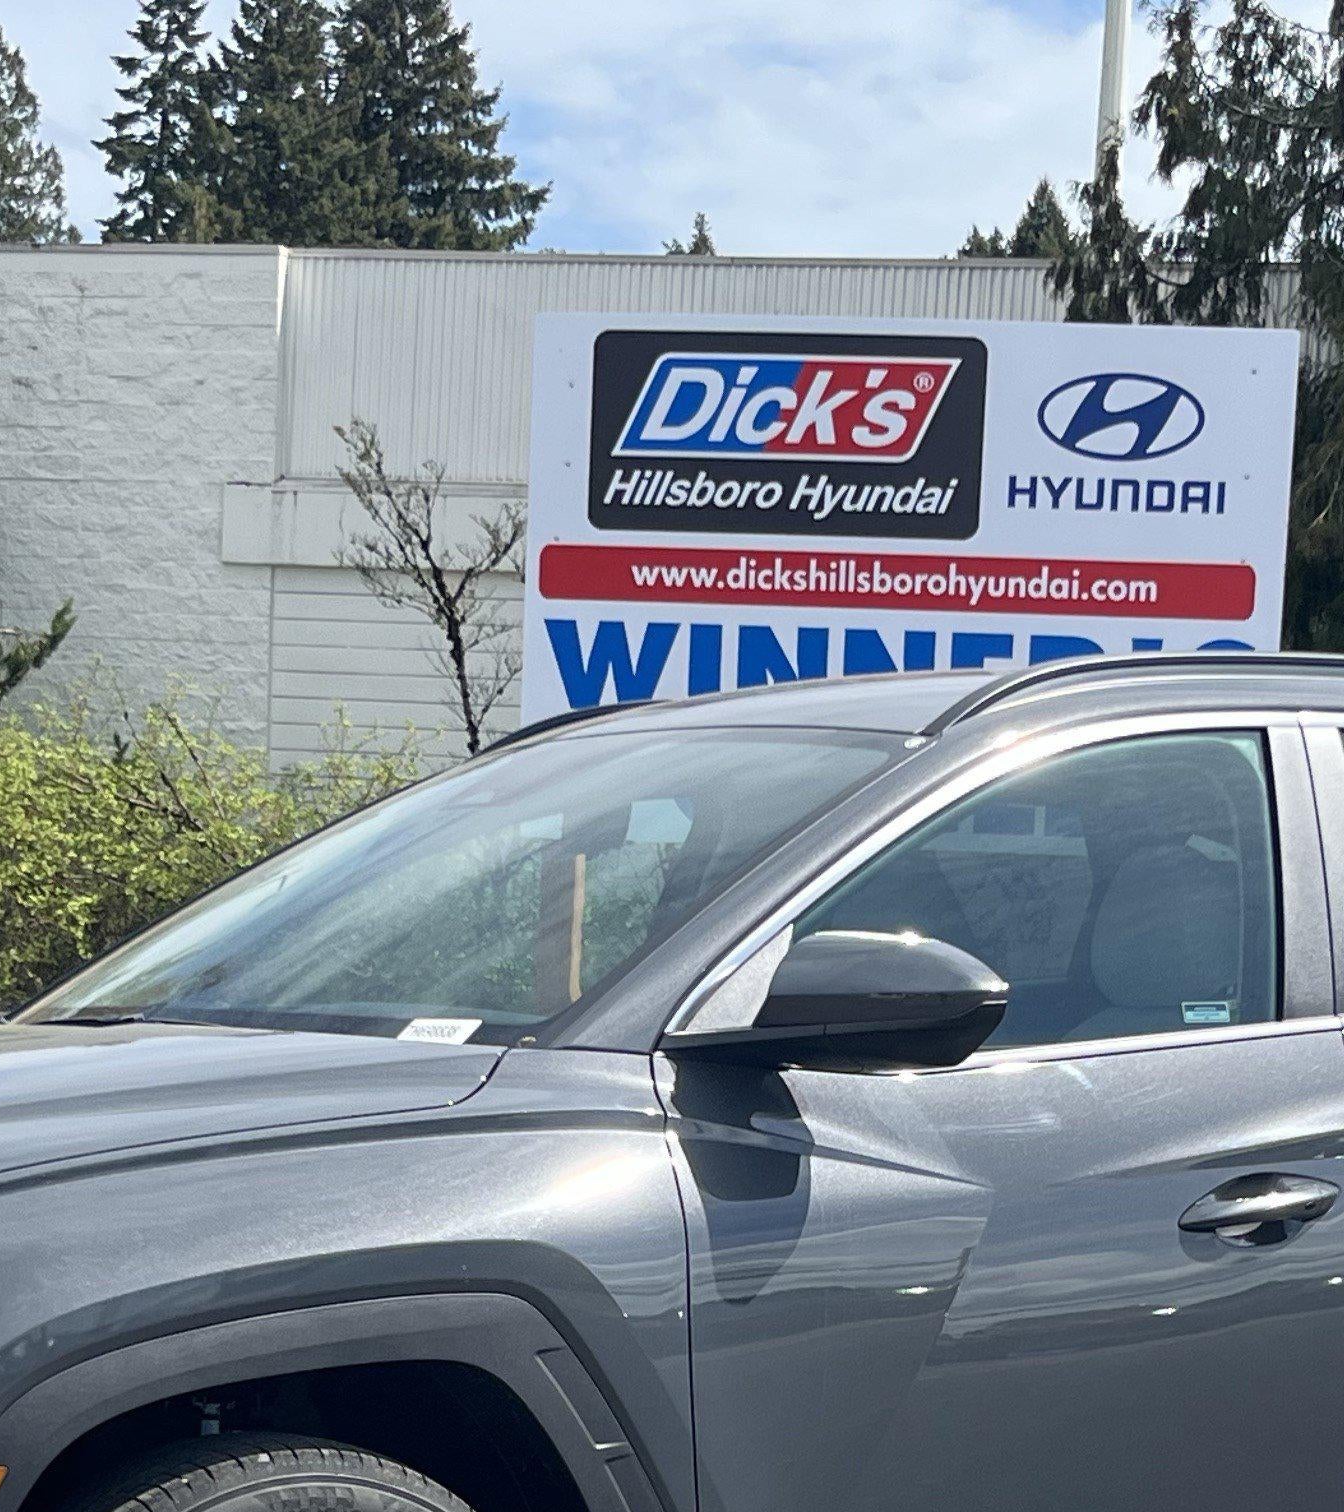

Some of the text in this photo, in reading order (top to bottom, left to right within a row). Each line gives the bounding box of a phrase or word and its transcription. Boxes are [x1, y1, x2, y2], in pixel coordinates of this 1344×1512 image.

[638, 366, 919, 449] Dick's
[603, 469, 960, 521] Hillsboro Hyundai
[1007, 475, 1226, 515] HYUNDAI
[631, 559, 1158, 607] www.dickshillsborohyundai.com
